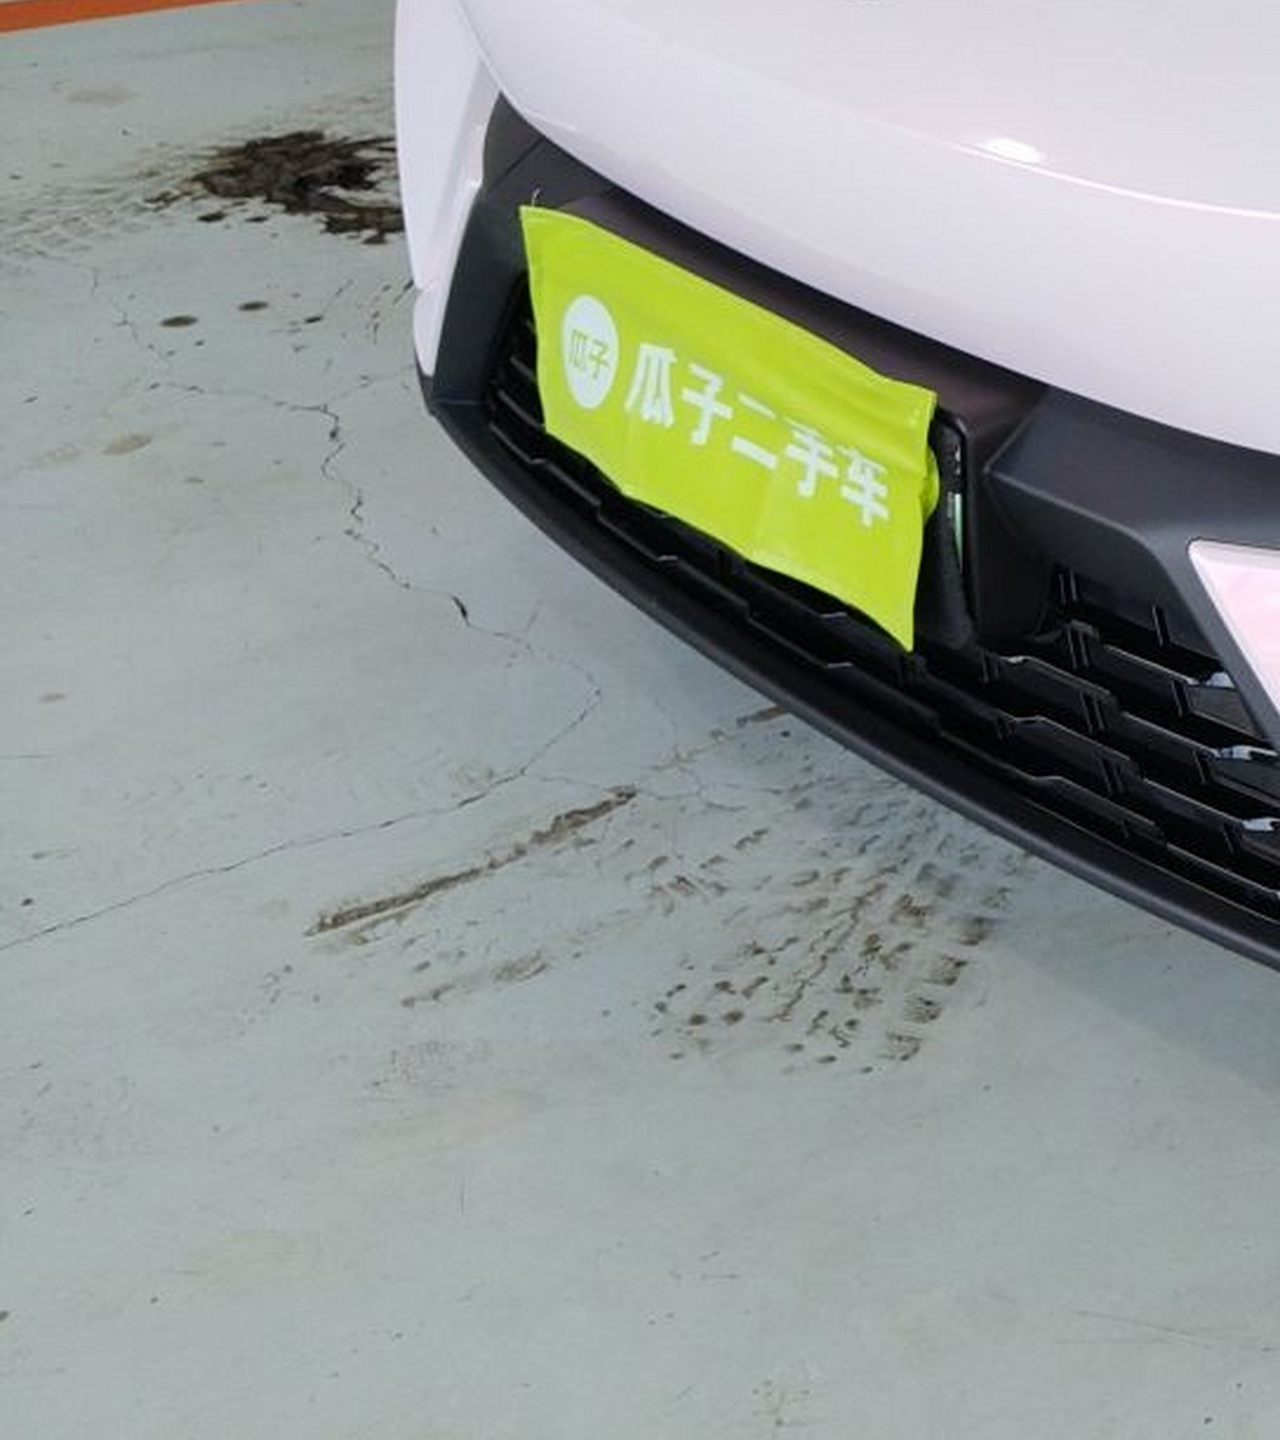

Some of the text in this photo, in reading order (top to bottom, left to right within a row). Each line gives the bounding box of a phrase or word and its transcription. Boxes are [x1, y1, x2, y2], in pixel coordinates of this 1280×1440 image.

[568, 327, 611, 380] 瓜子
[624, 342, 890, 529] 瓜子二手车
